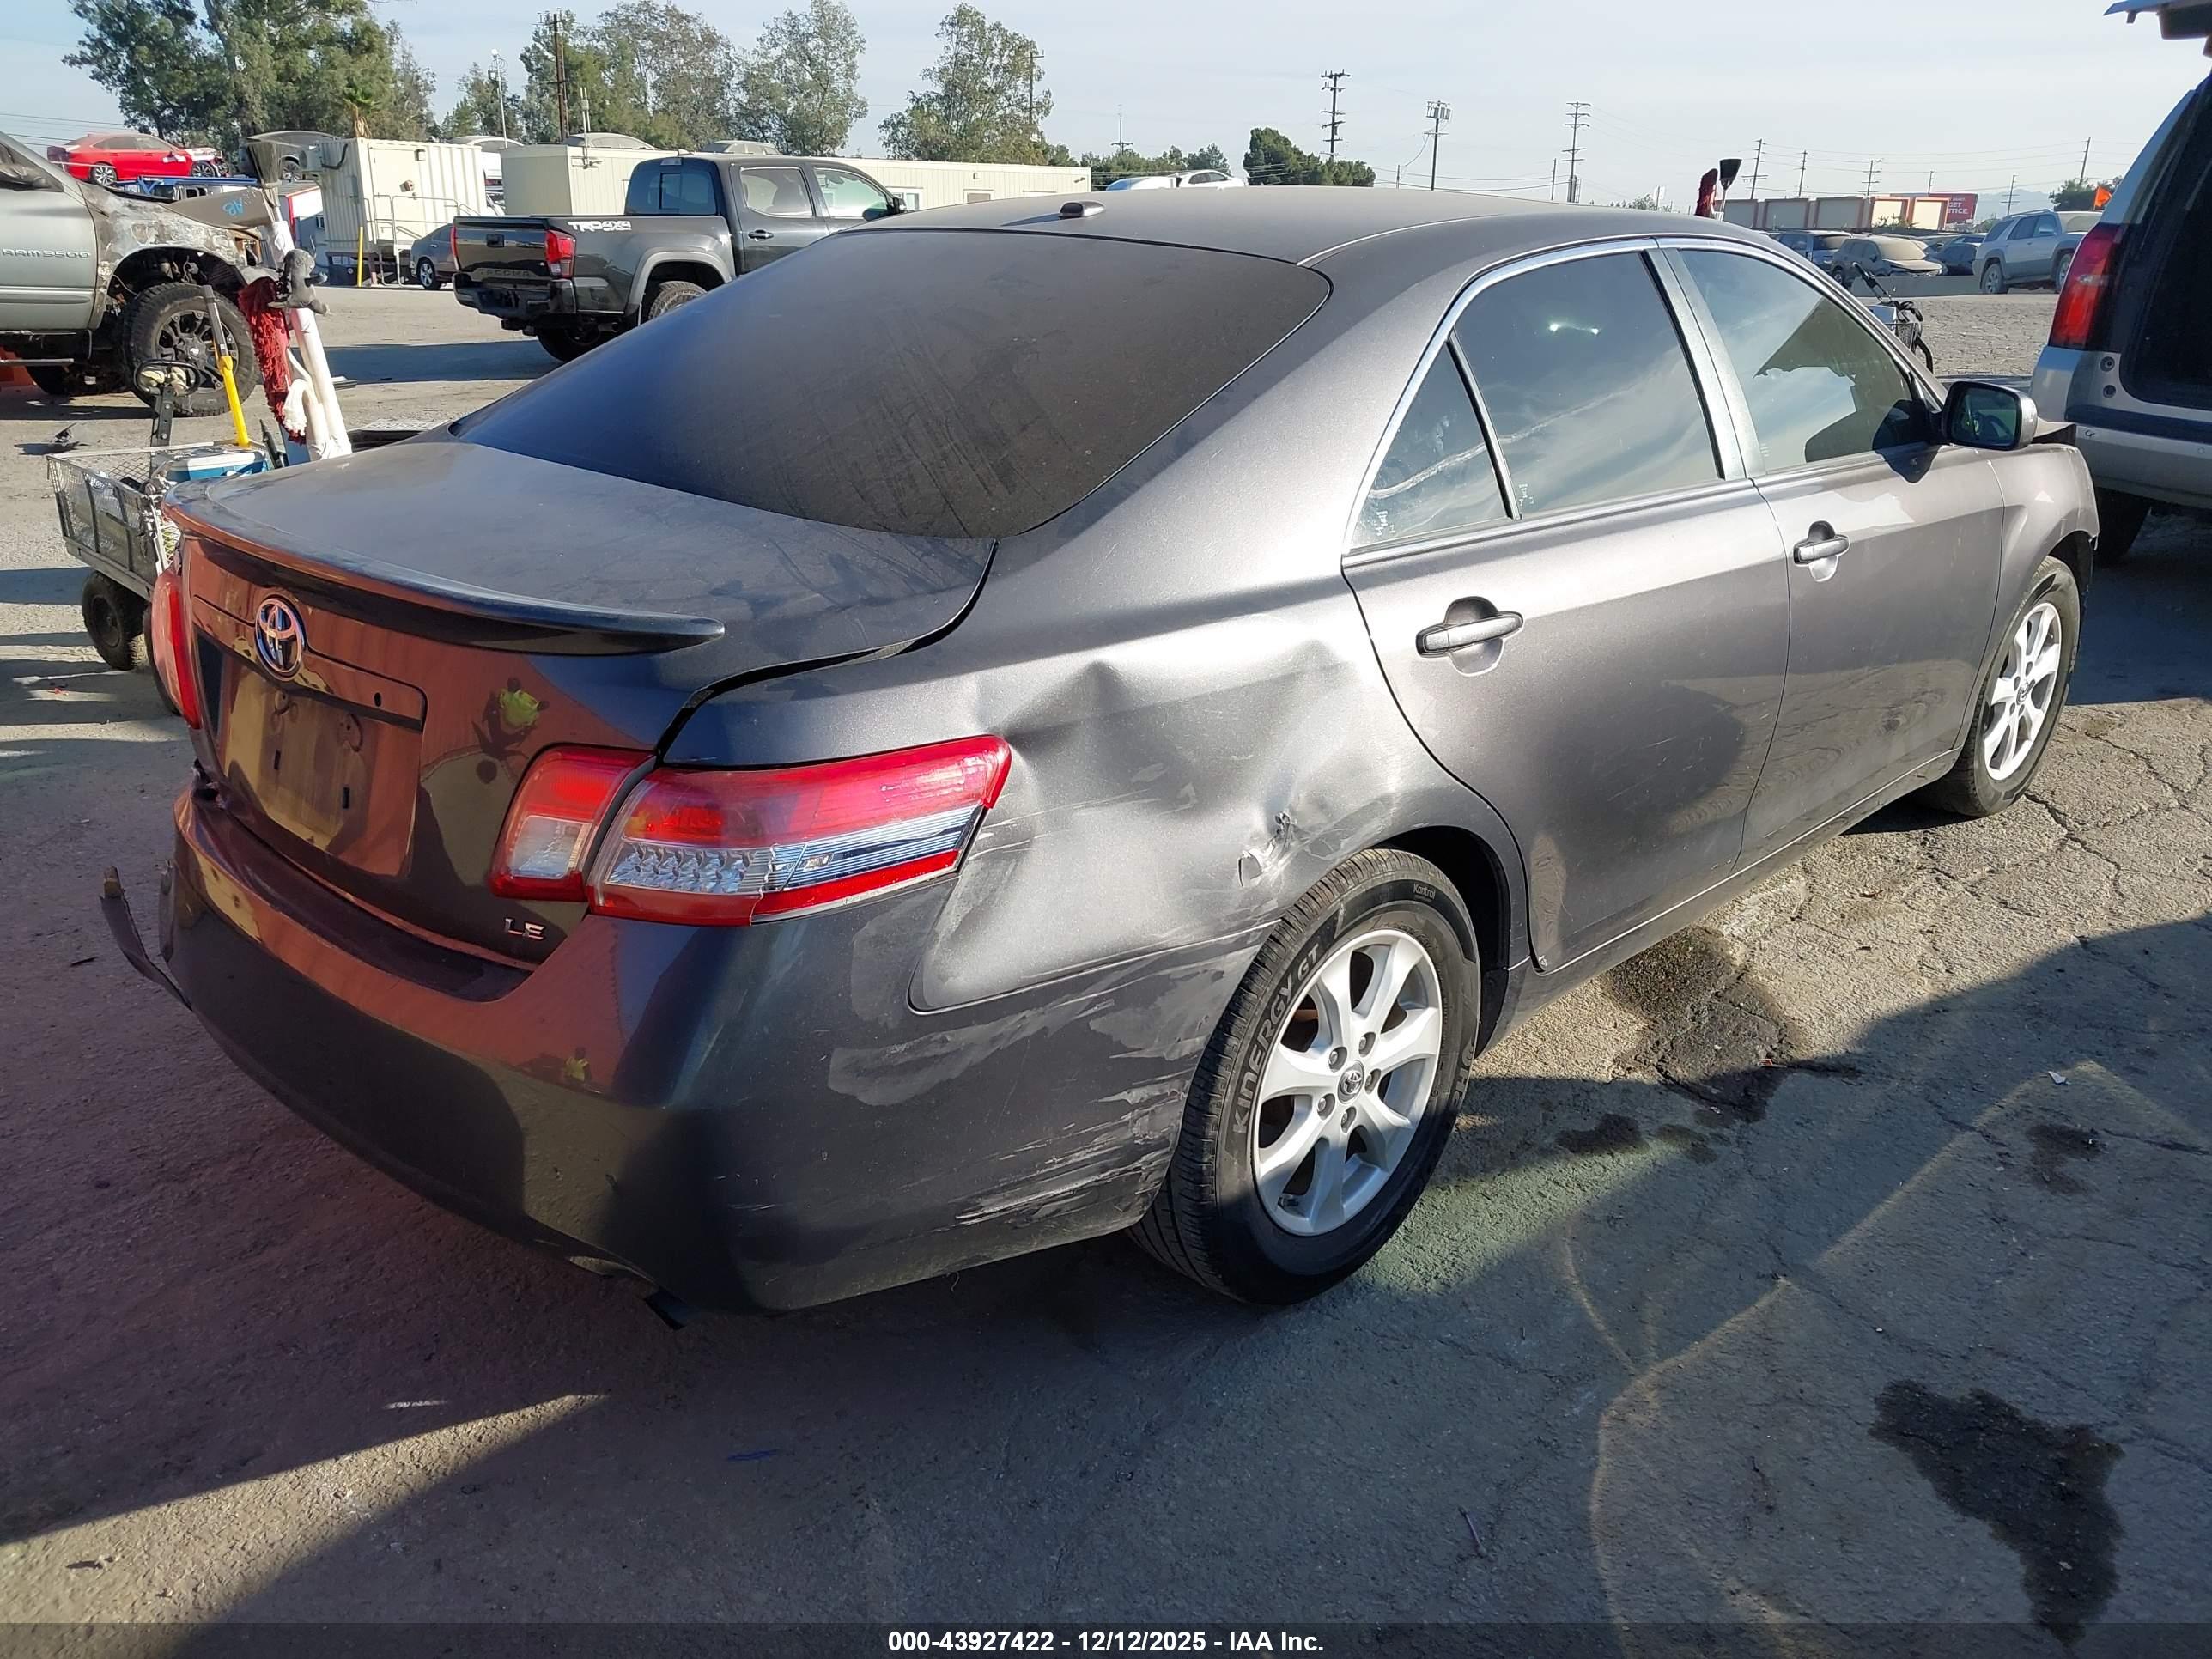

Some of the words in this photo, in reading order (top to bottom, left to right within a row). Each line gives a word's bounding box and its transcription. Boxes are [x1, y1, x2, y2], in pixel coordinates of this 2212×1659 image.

[2, 248, 41, 258] RAM
[42, 249, 91, 258] 3500
[504, 918, 545, 940] LE
[1232, 973, 1293, 1133] KINERGY
[1297, 944, 1320, 981] GT
